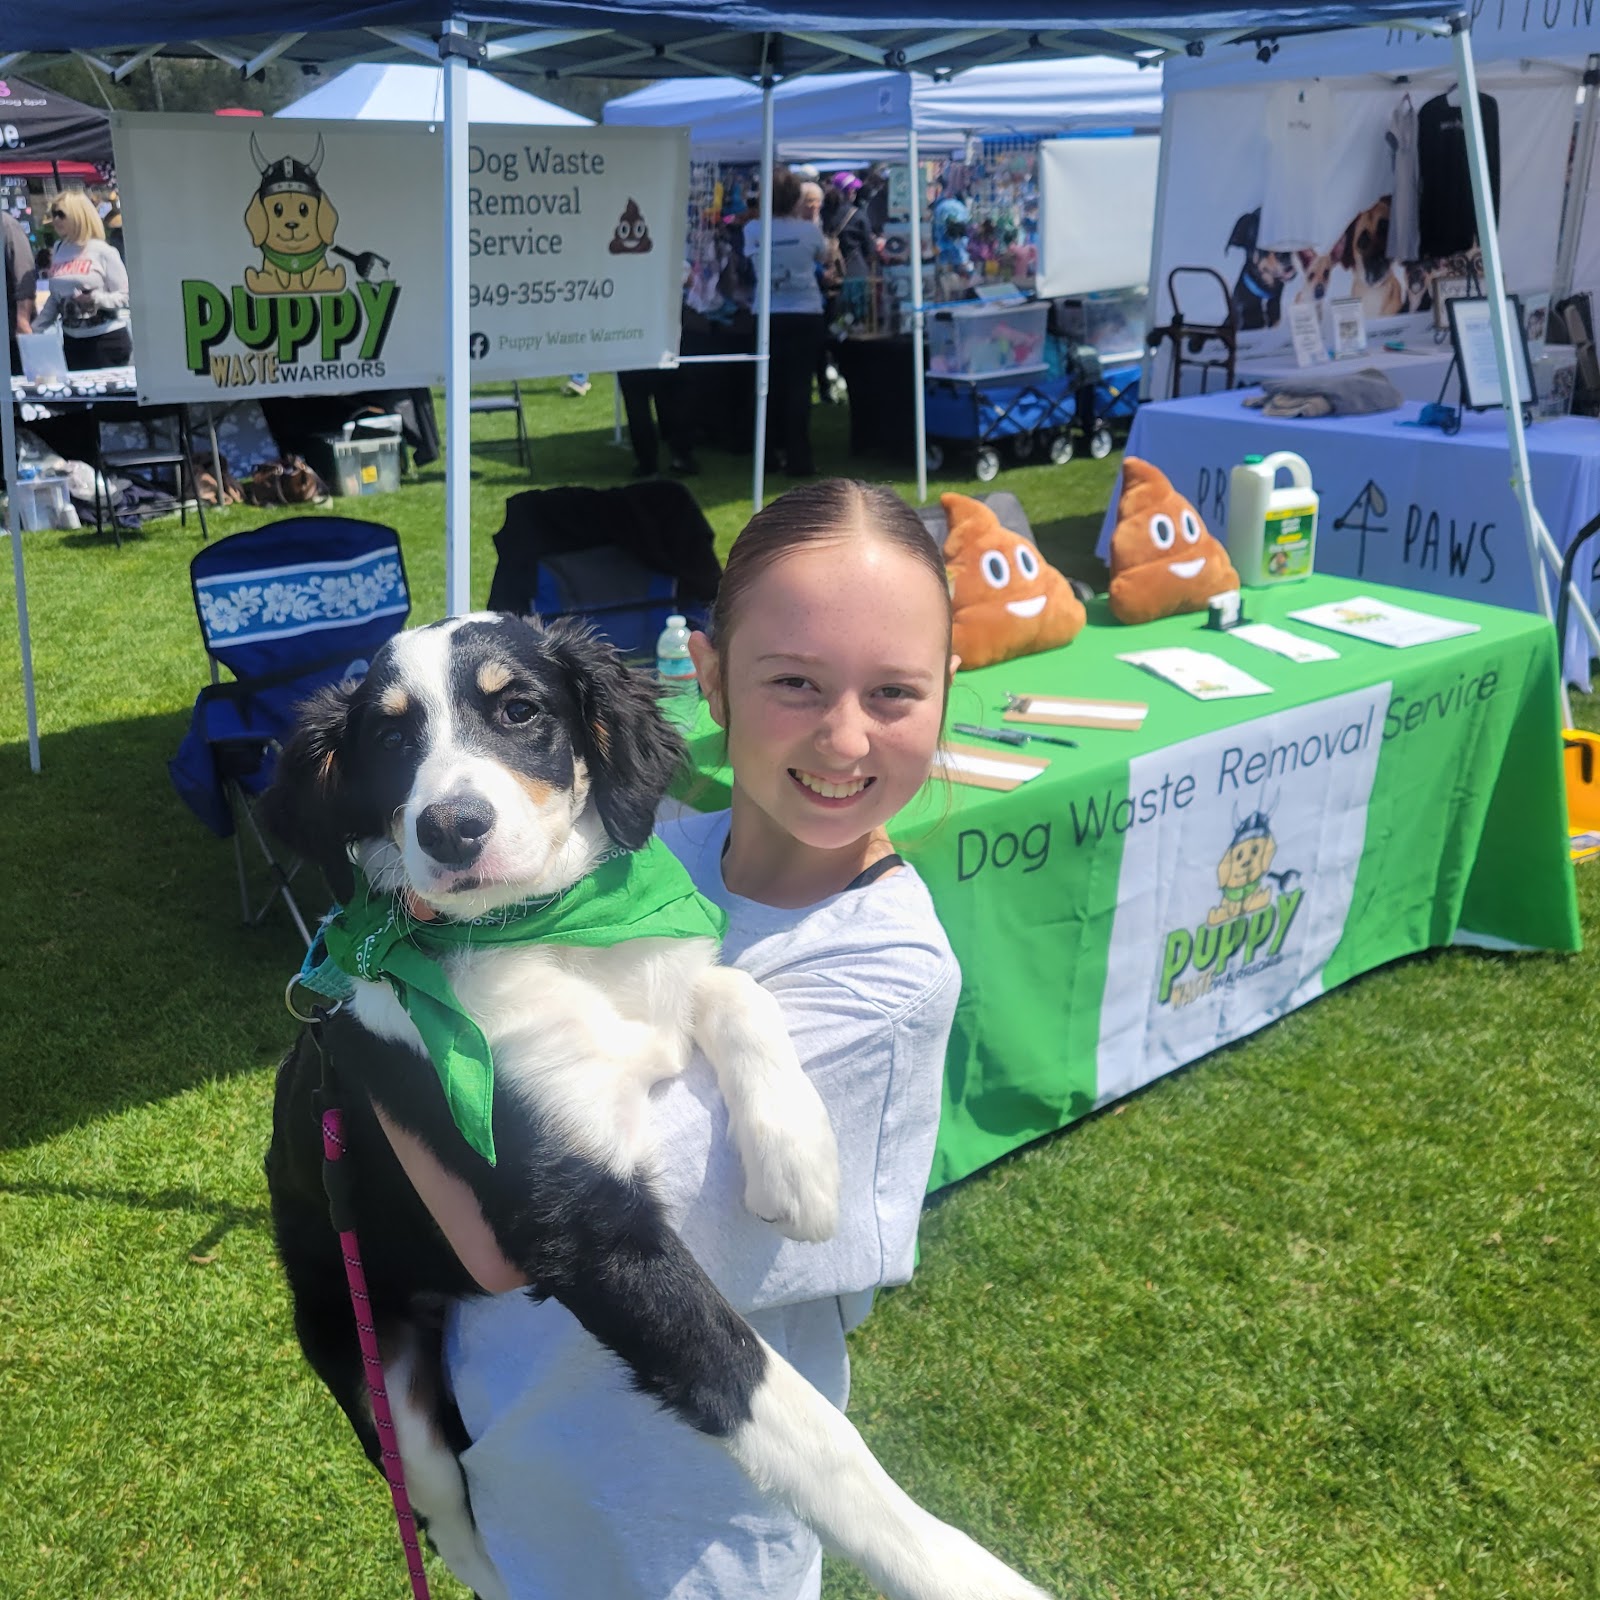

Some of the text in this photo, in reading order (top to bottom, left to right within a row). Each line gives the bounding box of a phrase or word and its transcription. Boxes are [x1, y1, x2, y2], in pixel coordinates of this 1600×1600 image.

[468, 144, 605, 182] Dog Waste
[468, 186, 581, 216] Removal
[468, 228, 563, 257] Service
[469, 278, 615, 307] 949-355-3740
[181, 279, 402, 376] PUPPY
[498, 334, 543, 351] Puppy
[546, 332, 586, 346] Waste
[590, 325, 645, 342] Warriors
[210, 351, 386, 388] WASTE WARRIORS
[1403, 503, 1497, 584] PAWS
[957, 669, 1499, 882] Dog Waste Removal Service
[1157, 886, 1305, 1006] PUPPY
